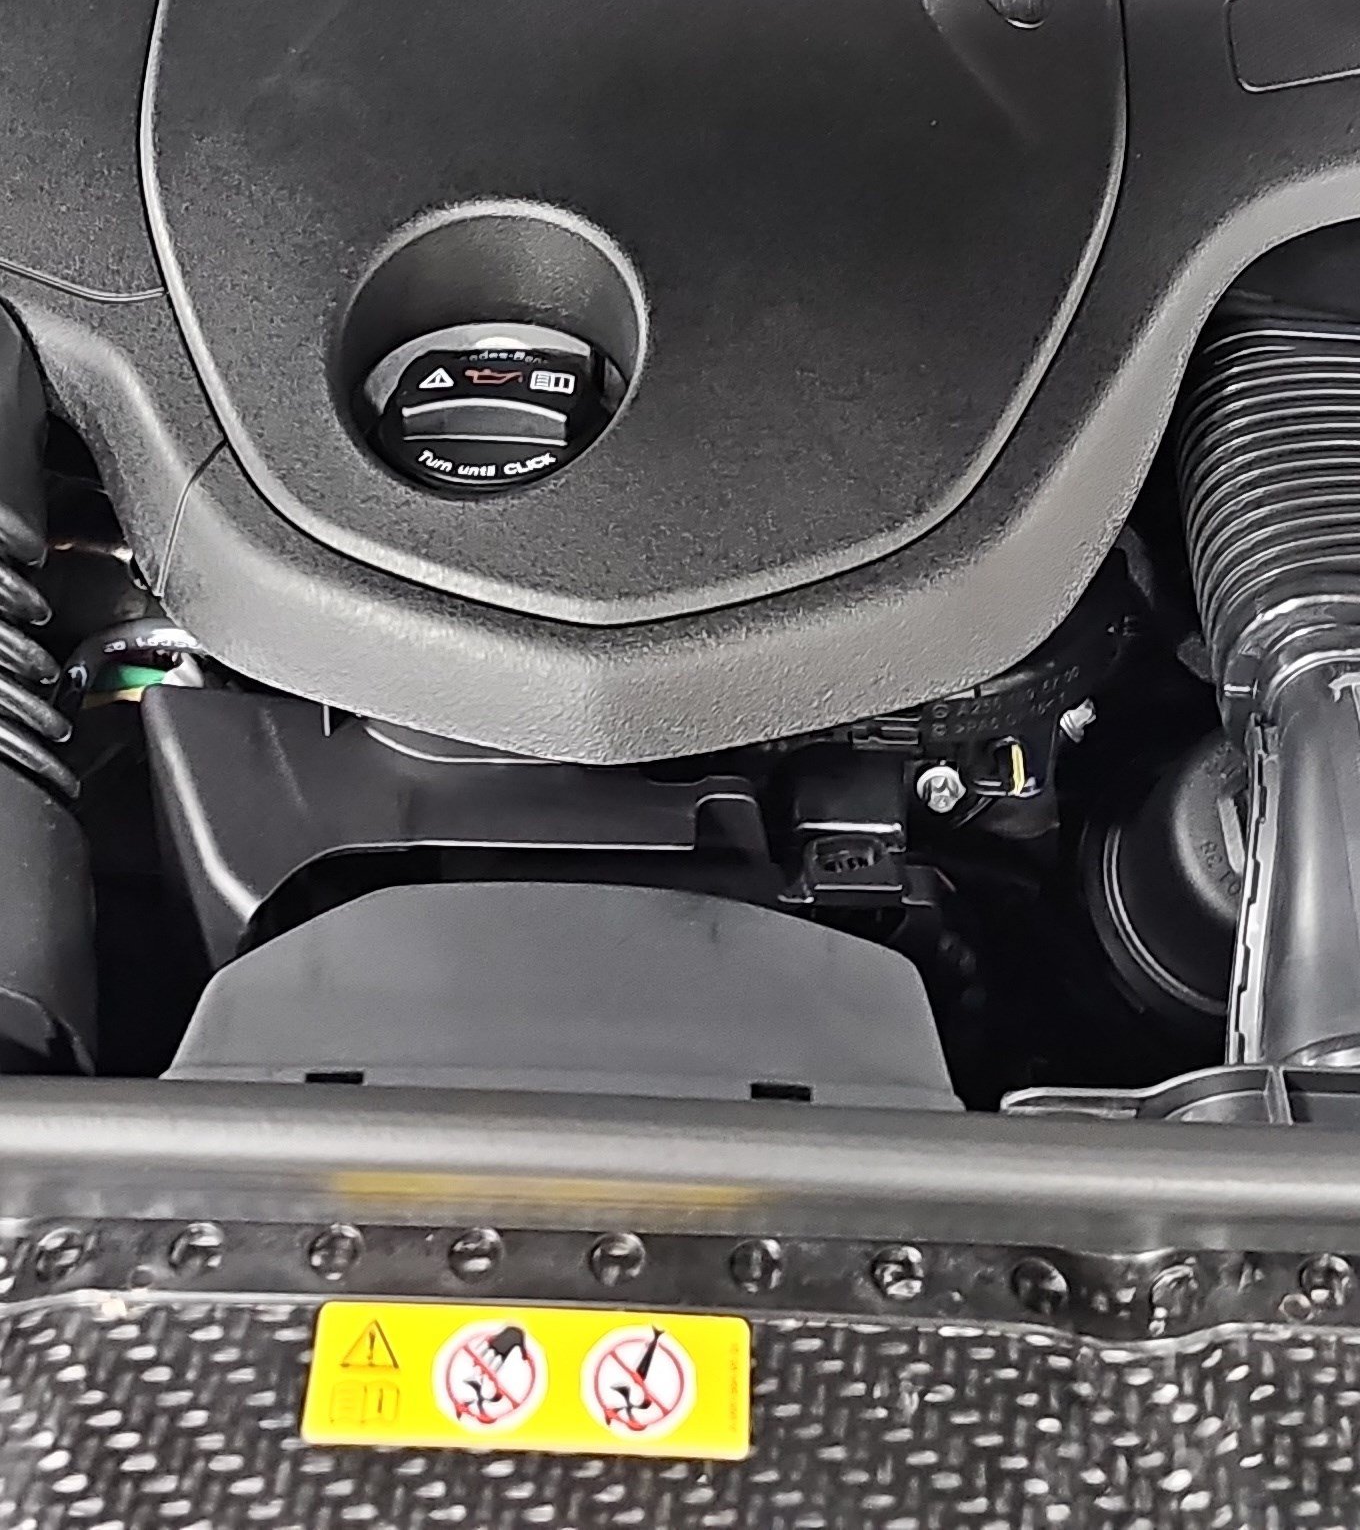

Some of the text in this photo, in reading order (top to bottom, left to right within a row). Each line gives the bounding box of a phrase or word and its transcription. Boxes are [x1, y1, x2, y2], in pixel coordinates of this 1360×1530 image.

[419, 449, 557, 478] Turn until CLICK
